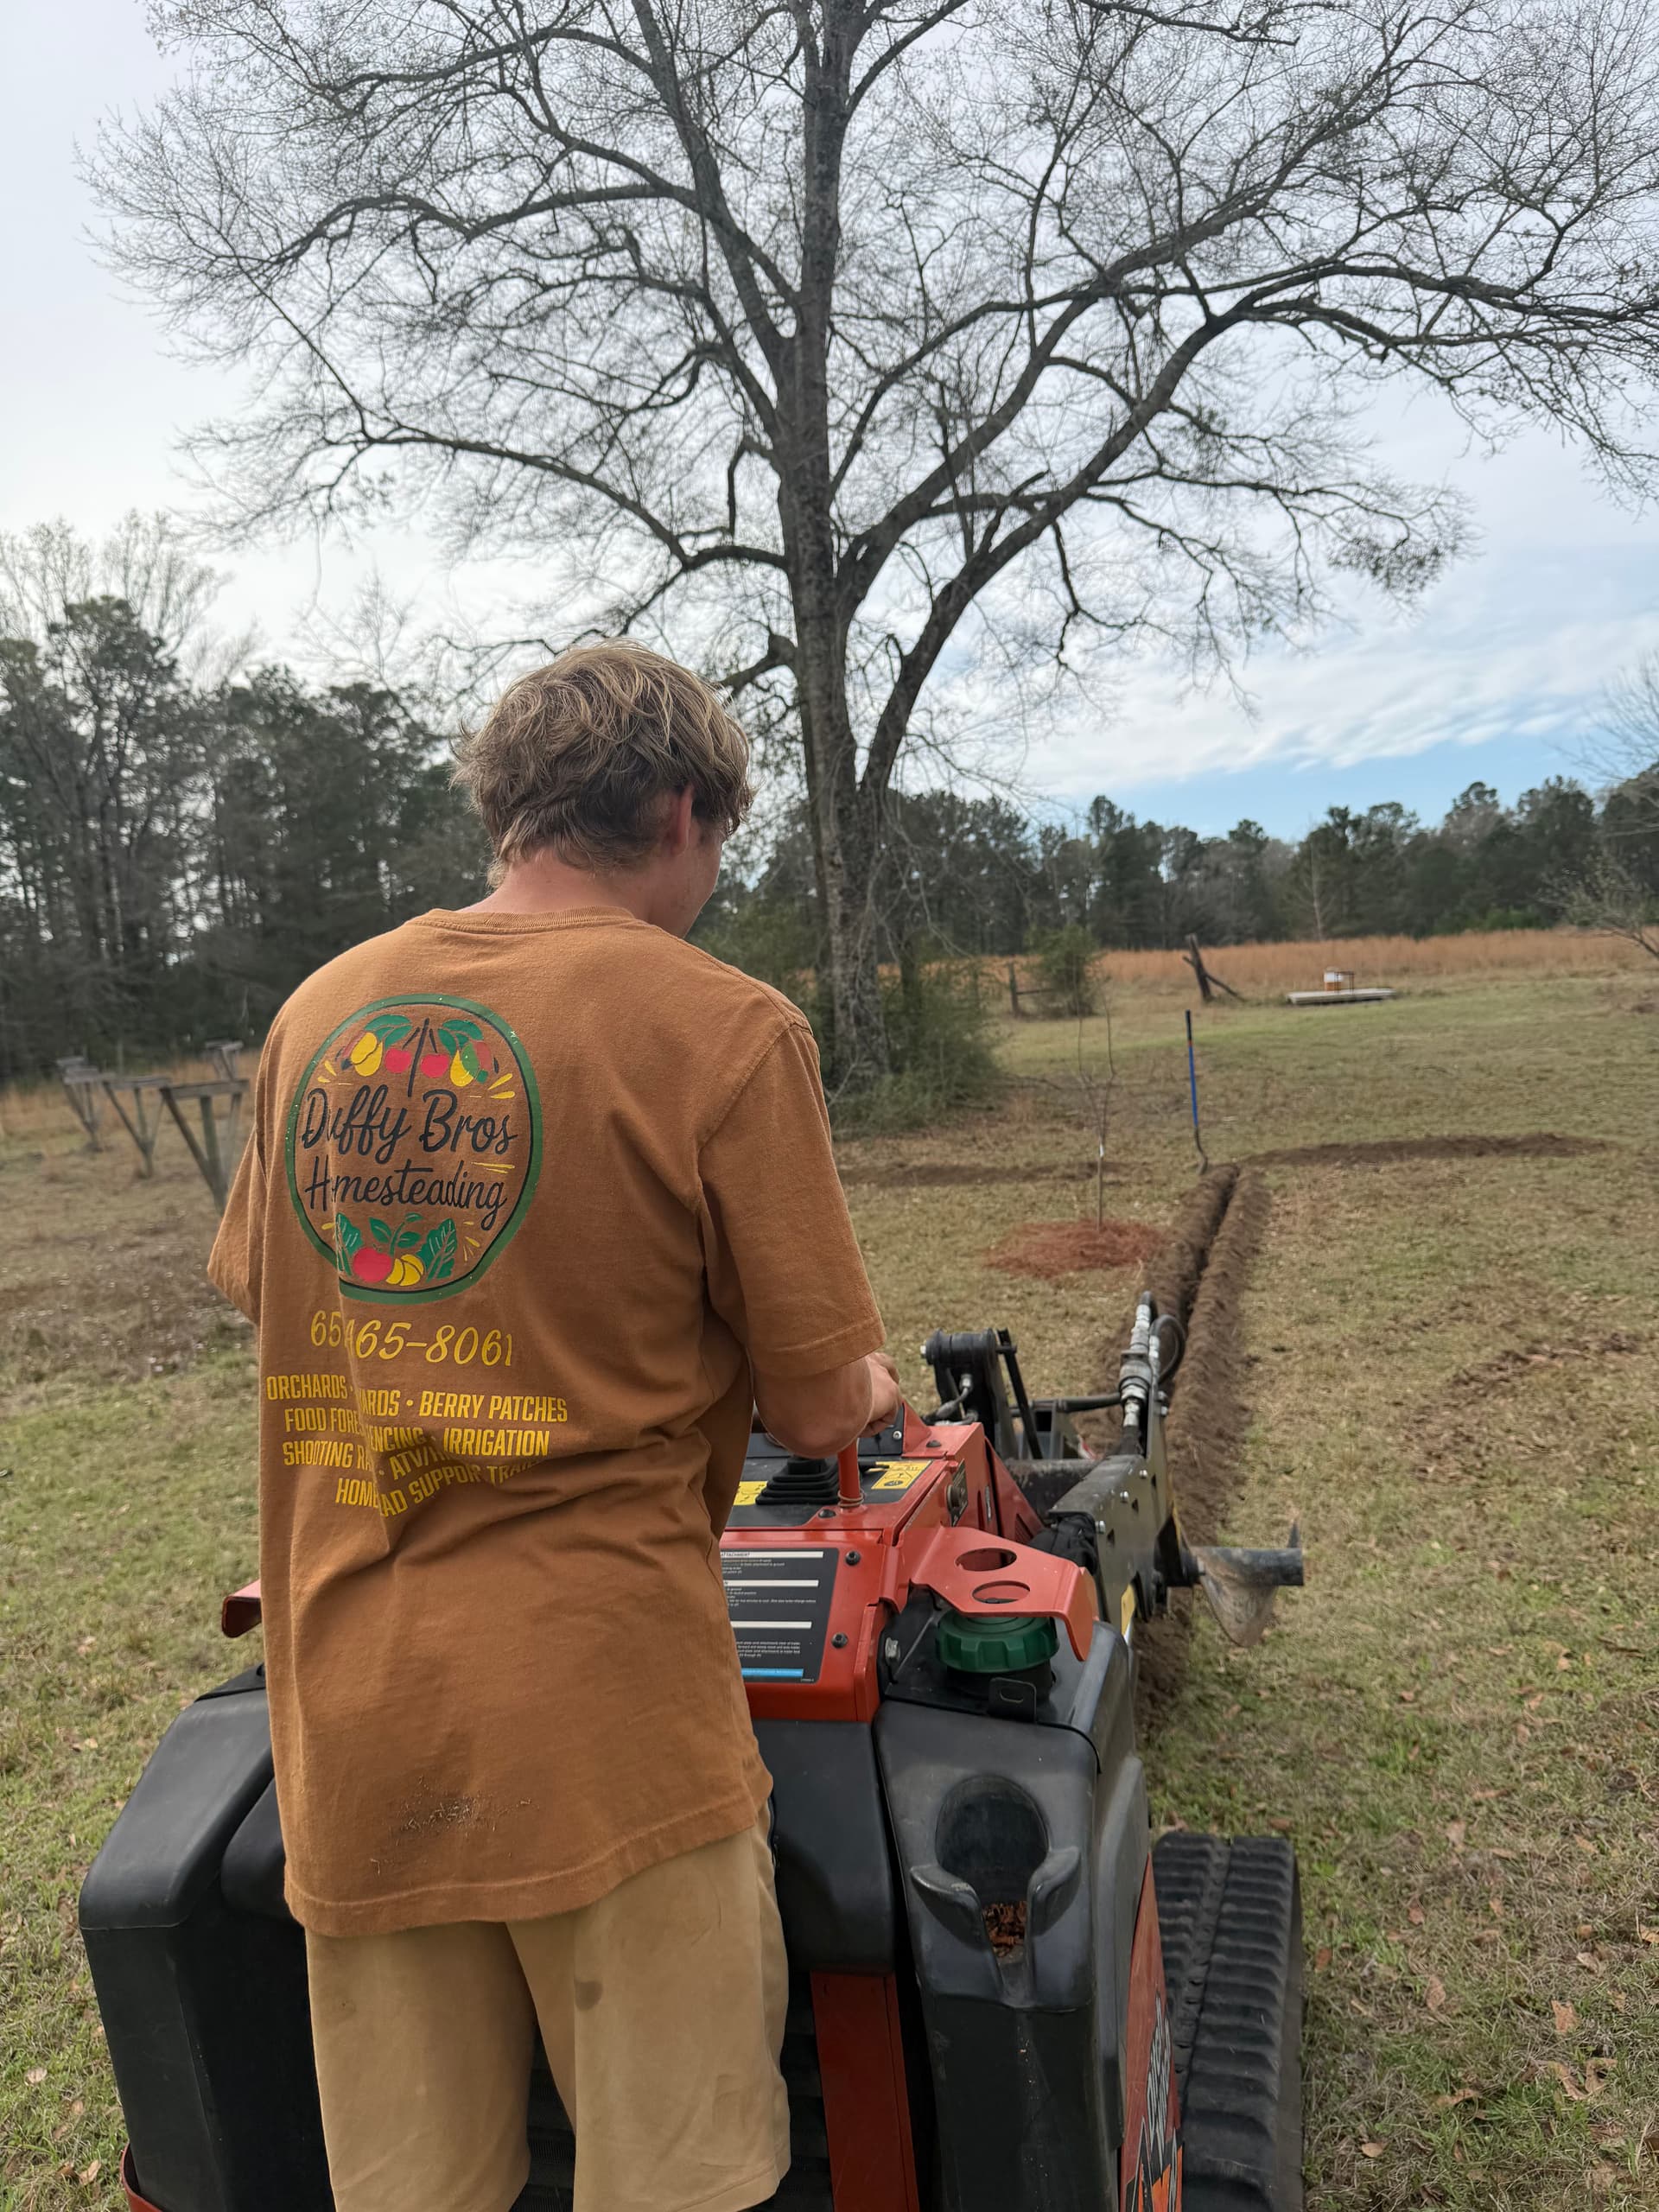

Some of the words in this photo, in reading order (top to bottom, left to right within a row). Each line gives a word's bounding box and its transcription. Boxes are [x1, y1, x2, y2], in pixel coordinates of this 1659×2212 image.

[419, 1089, 518, 1155] Bros
[304, 1154, 508, 1231] Hmesteading
[266, 1374, 347, 1400] ORCHARDS
[419, 1390, 485, 1419] BERRY
[488, 1395, 568, 1422] PATCHES
[283, 1440, 353, 1468] SHOOTING
[284, 1408, 327, 1432] FOOD
[443, 1427, 550, 1457] IRRIGATION
